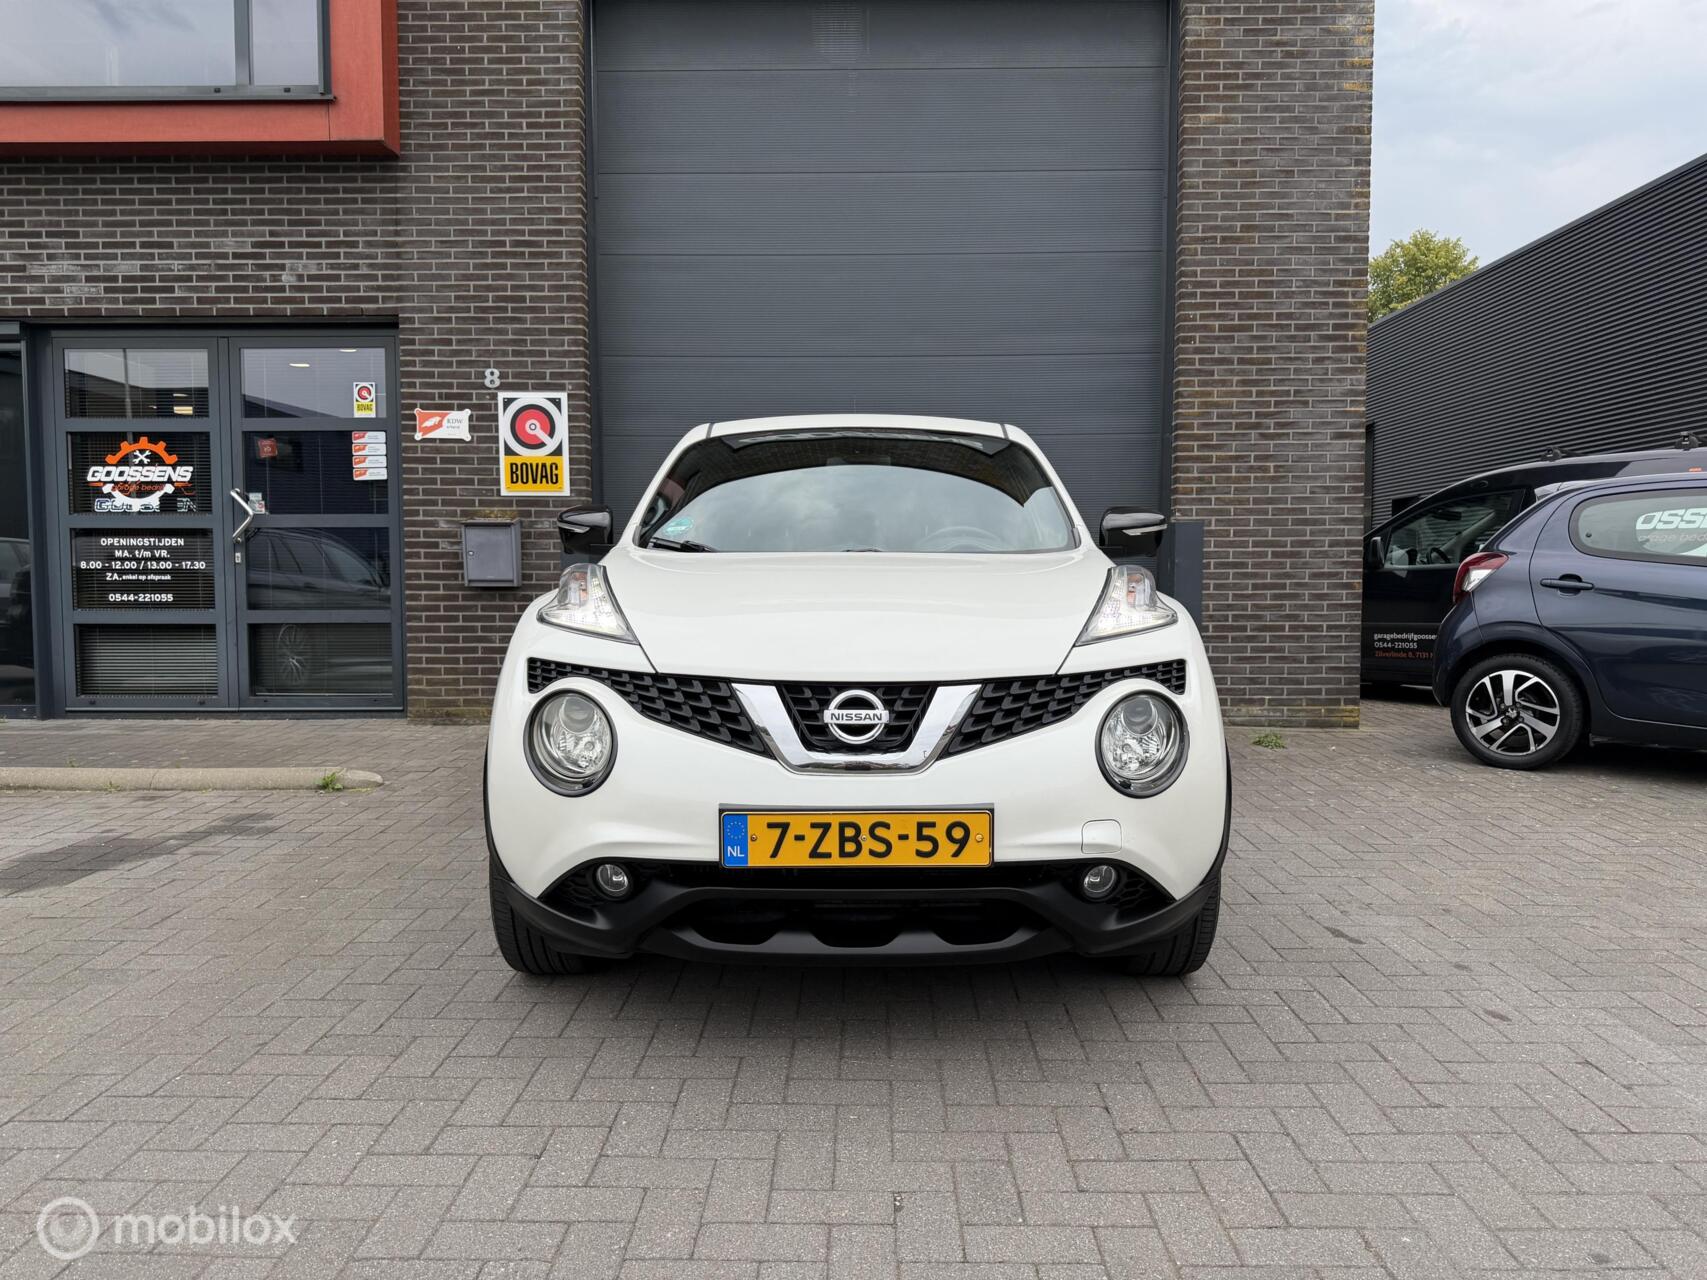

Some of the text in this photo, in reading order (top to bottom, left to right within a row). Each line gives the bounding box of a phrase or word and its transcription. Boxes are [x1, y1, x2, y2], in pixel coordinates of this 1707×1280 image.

[484, 368, 500, 389] 8
[356, 404, 373, 412] BOVAG
[87, 466, 194, 482] GOOSSENS
[509, 462, 559, 485] BOVAG
[100, 538, 185, 546] OPENINGSTIJDEN
[114, 549, 170, 558] MA. t/m VR.
[80, 561, 103, 569] 8.00
[111, 561, 137, 569] 12.00
[139, 561, 145, 570] /
[147, 561, 173, 569] 13.00
[182, 561, 206, 569] 17.30
[105, 572, 122, 581] ZA.
[108, 593, 174, 602] 0544-221055
[1374, 641, 1418, 649] 0544-221055
[830, 712, 883, 722] NISSAN
[766, 820, 971, 859] 7-ZBS-59
[727, 846, 745, 858] NL
